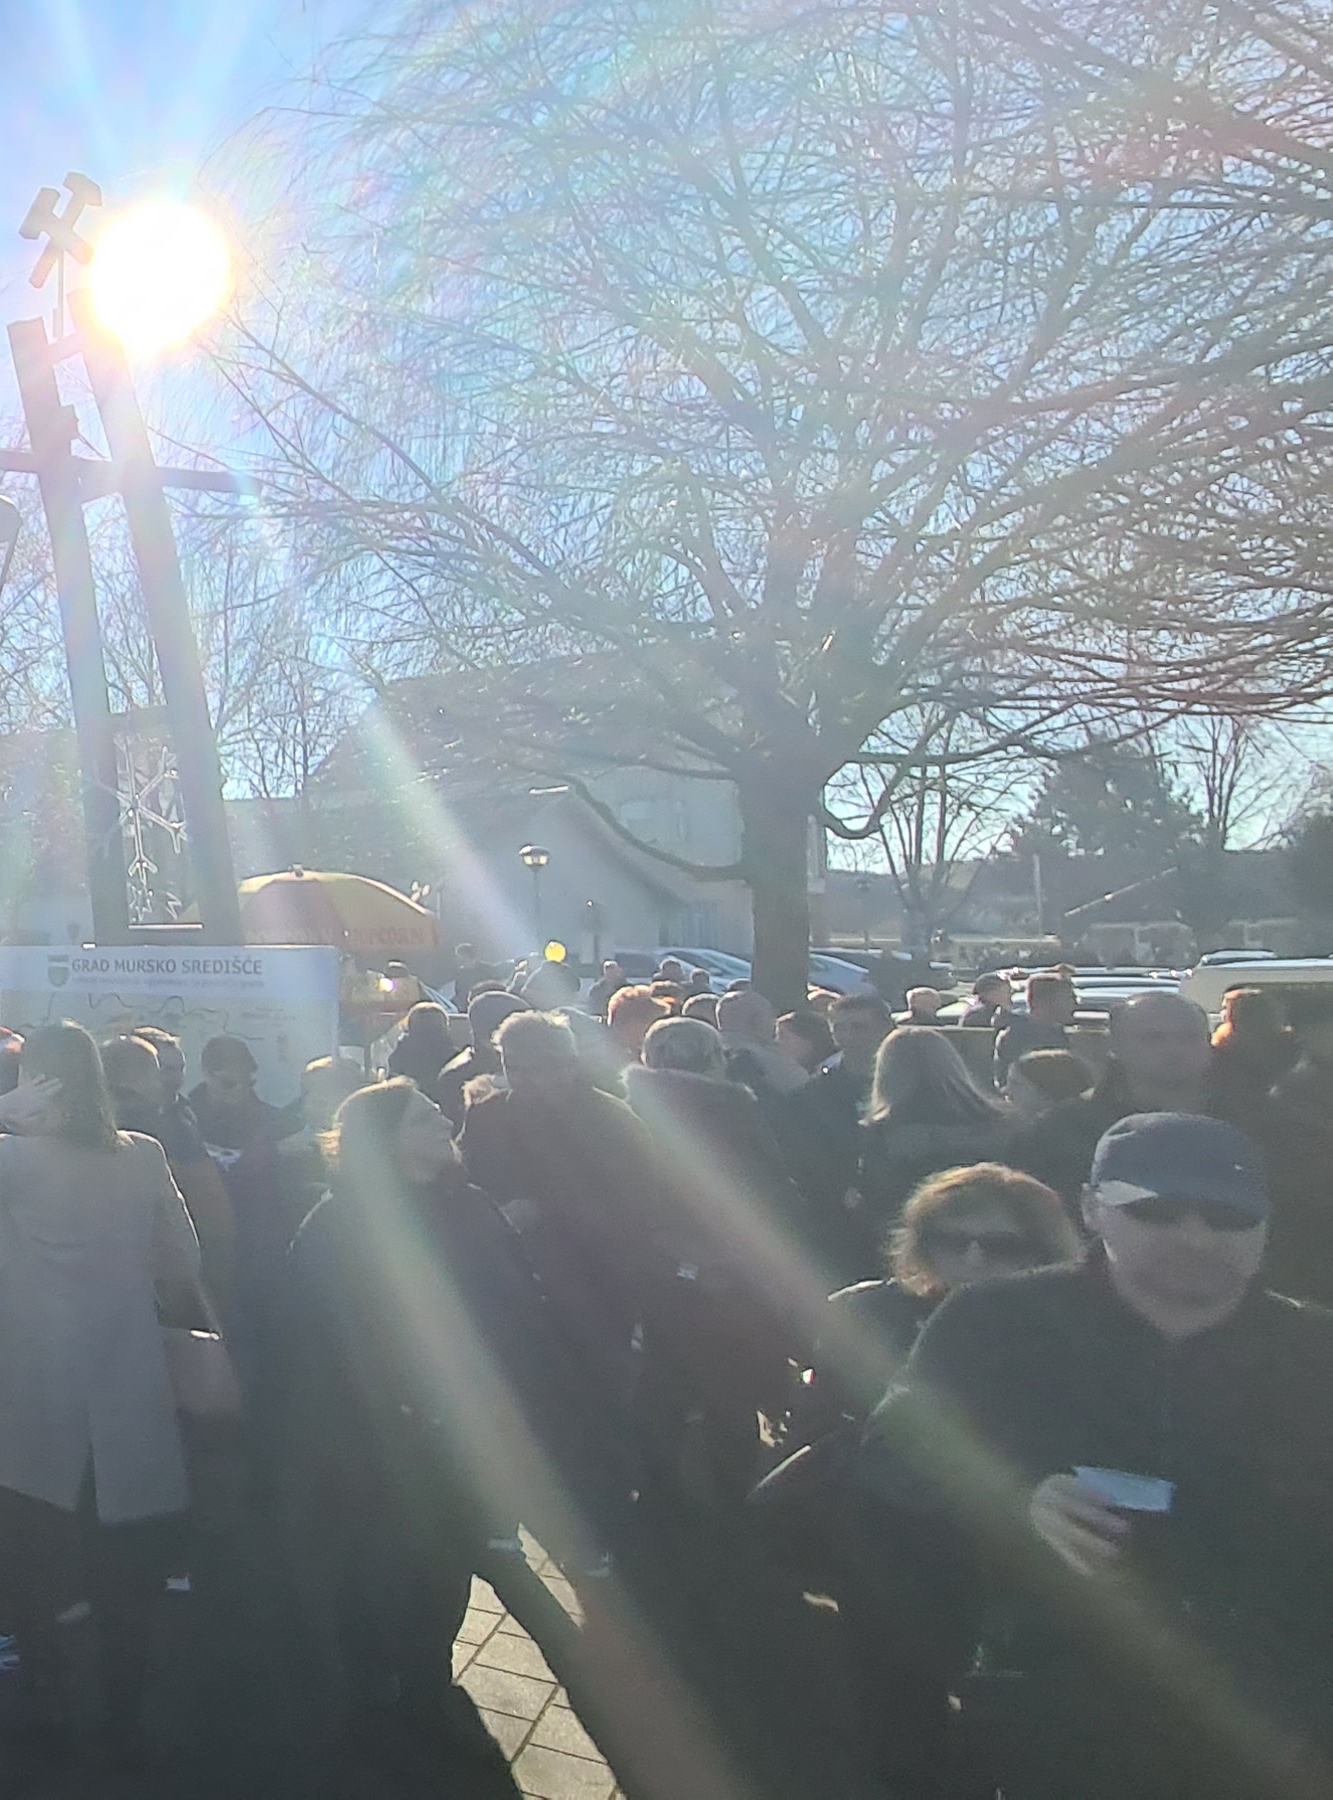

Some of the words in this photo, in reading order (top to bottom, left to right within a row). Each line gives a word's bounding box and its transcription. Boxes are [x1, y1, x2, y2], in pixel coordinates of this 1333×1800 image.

[71, 958, 110, 973] GRAD
[114, 958, 177, 974] MURSKO
[181, 954, 263, 975] SREDIŠĆE
